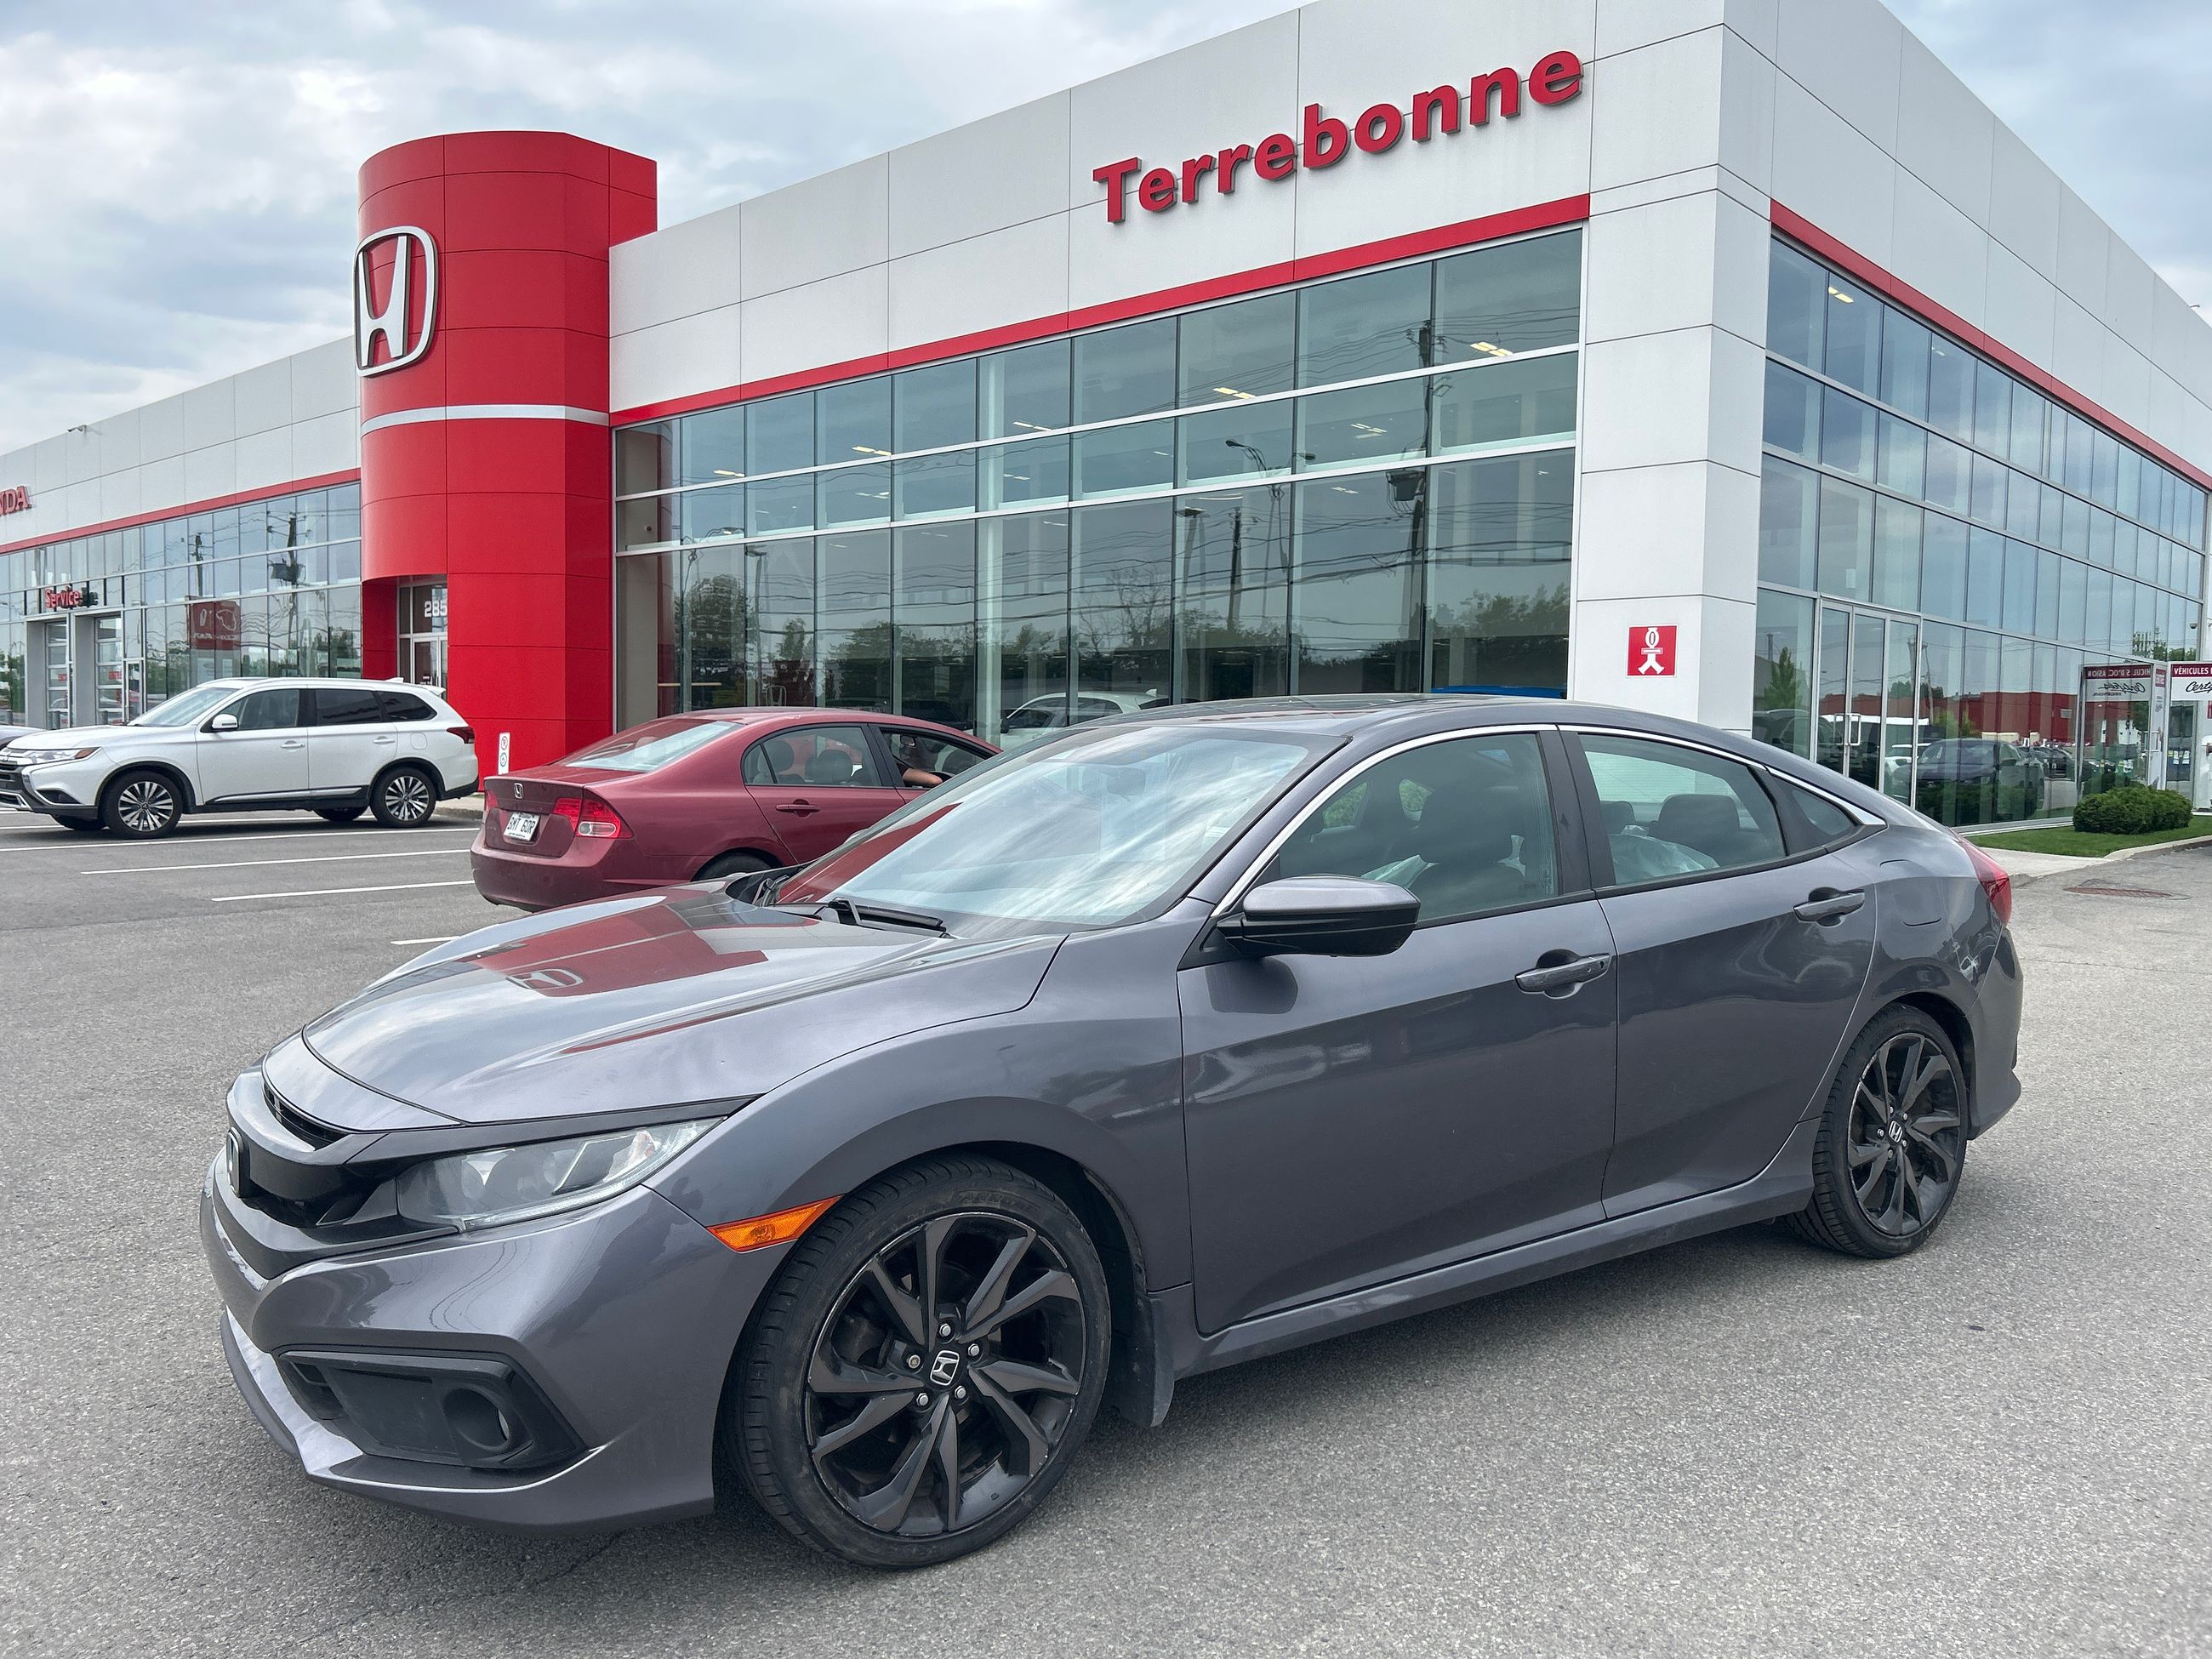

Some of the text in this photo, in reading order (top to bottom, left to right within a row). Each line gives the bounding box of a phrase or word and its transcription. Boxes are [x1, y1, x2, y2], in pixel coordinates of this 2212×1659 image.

[1092, 49, 1583, 224] Terrebonne
[45, 584, 81, 609] Service
[2174, 666, 2209, 675] VÉHICULES
